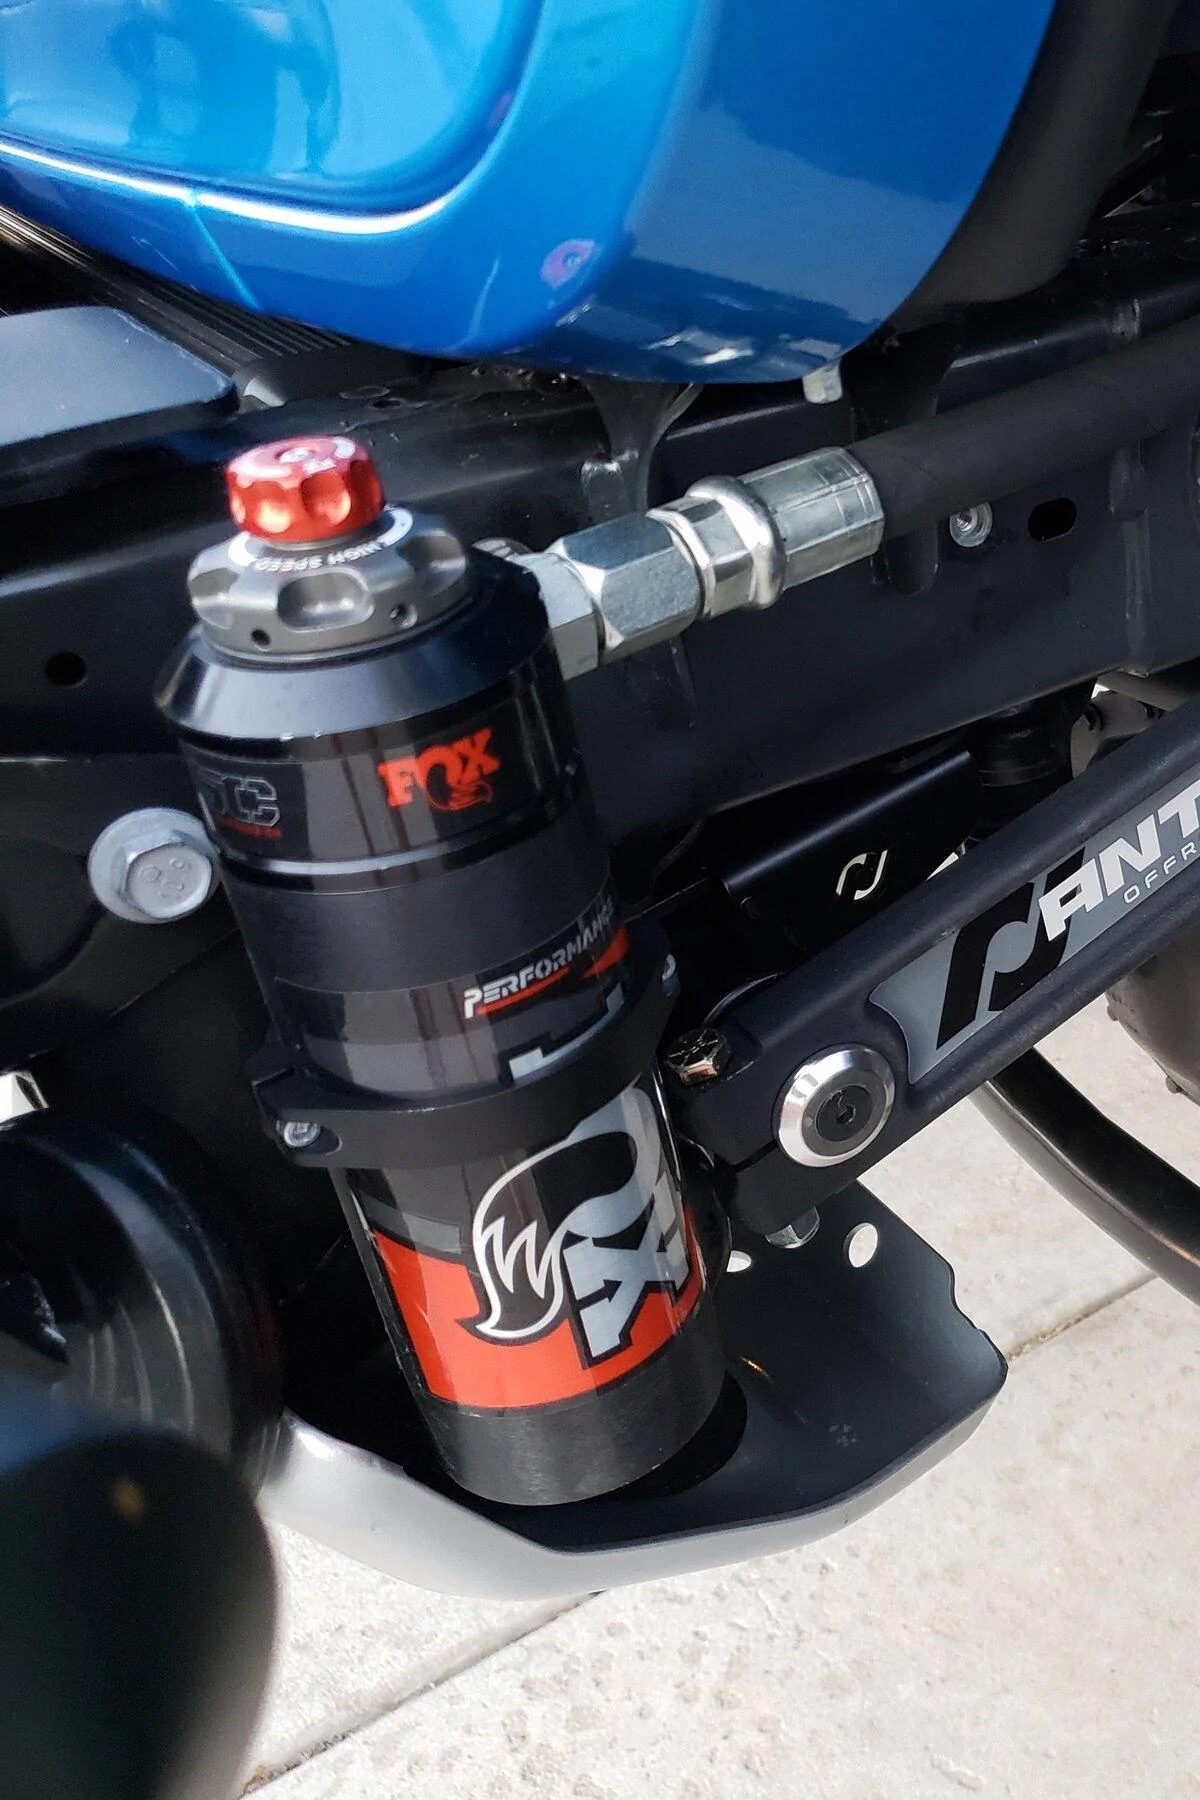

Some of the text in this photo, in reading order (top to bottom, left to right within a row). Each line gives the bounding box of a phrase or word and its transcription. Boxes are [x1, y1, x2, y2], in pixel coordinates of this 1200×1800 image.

[254, 541, 383, 572] HIGH SPEED
[376, 726, 501, 811] FOX
